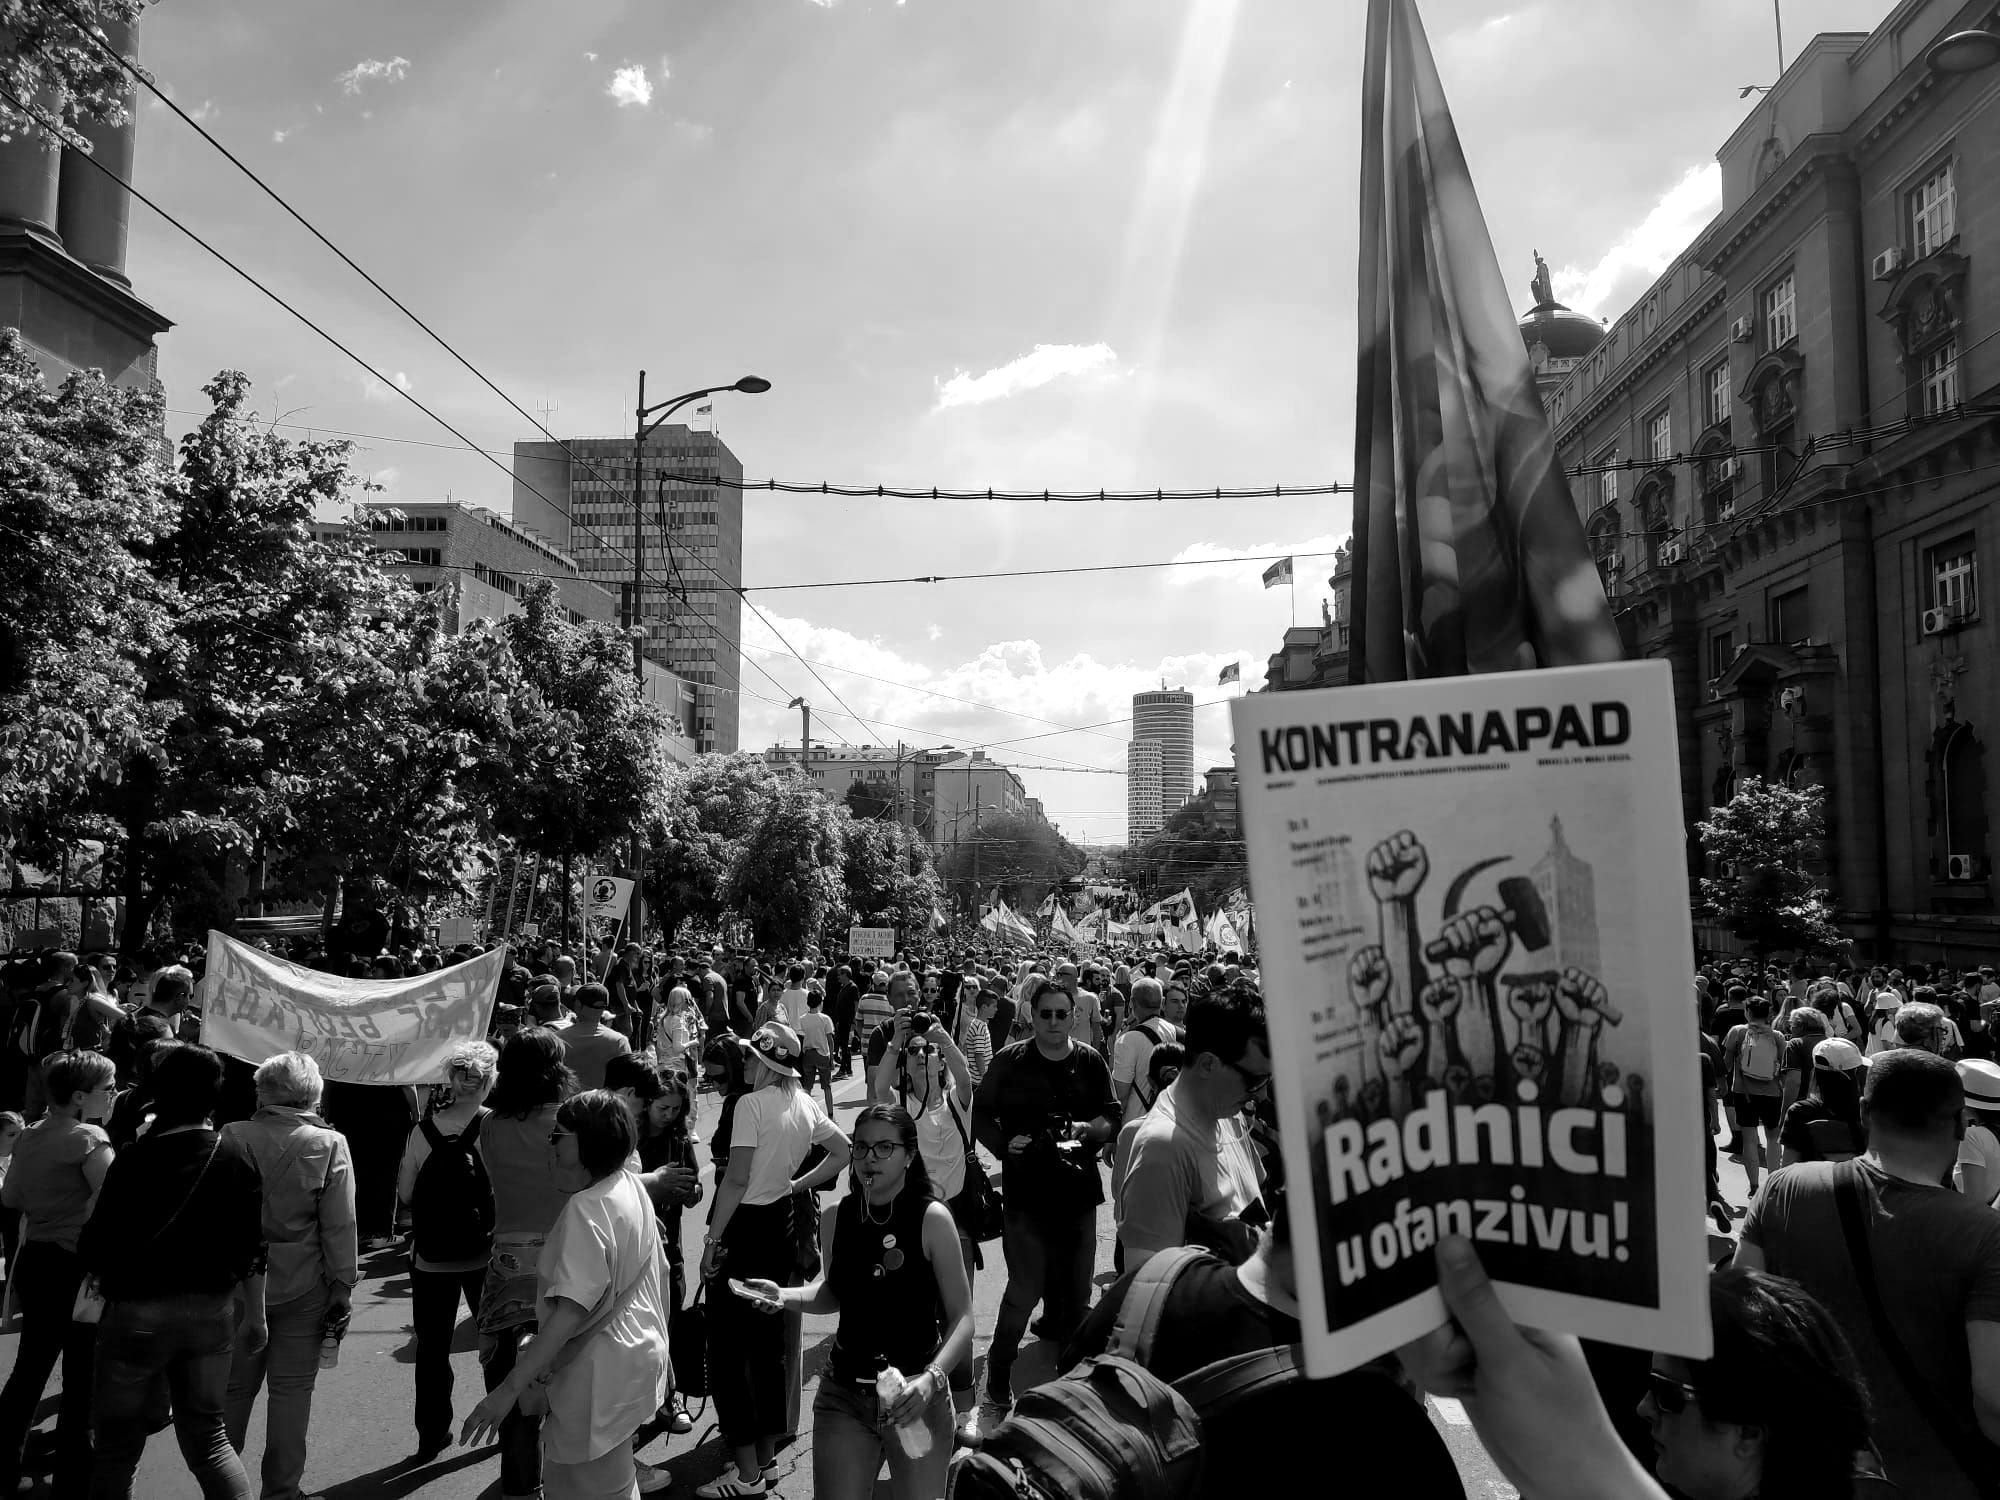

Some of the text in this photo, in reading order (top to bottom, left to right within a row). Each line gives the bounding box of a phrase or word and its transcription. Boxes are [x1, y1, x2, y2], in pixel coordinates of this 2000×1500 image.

[1259, 701, 1631, 774] KONTRANAPAD
[1325, 1079, 1627, 1205] Radnici
[1336, 1184, 1630, 1287] u ofanzivu!
